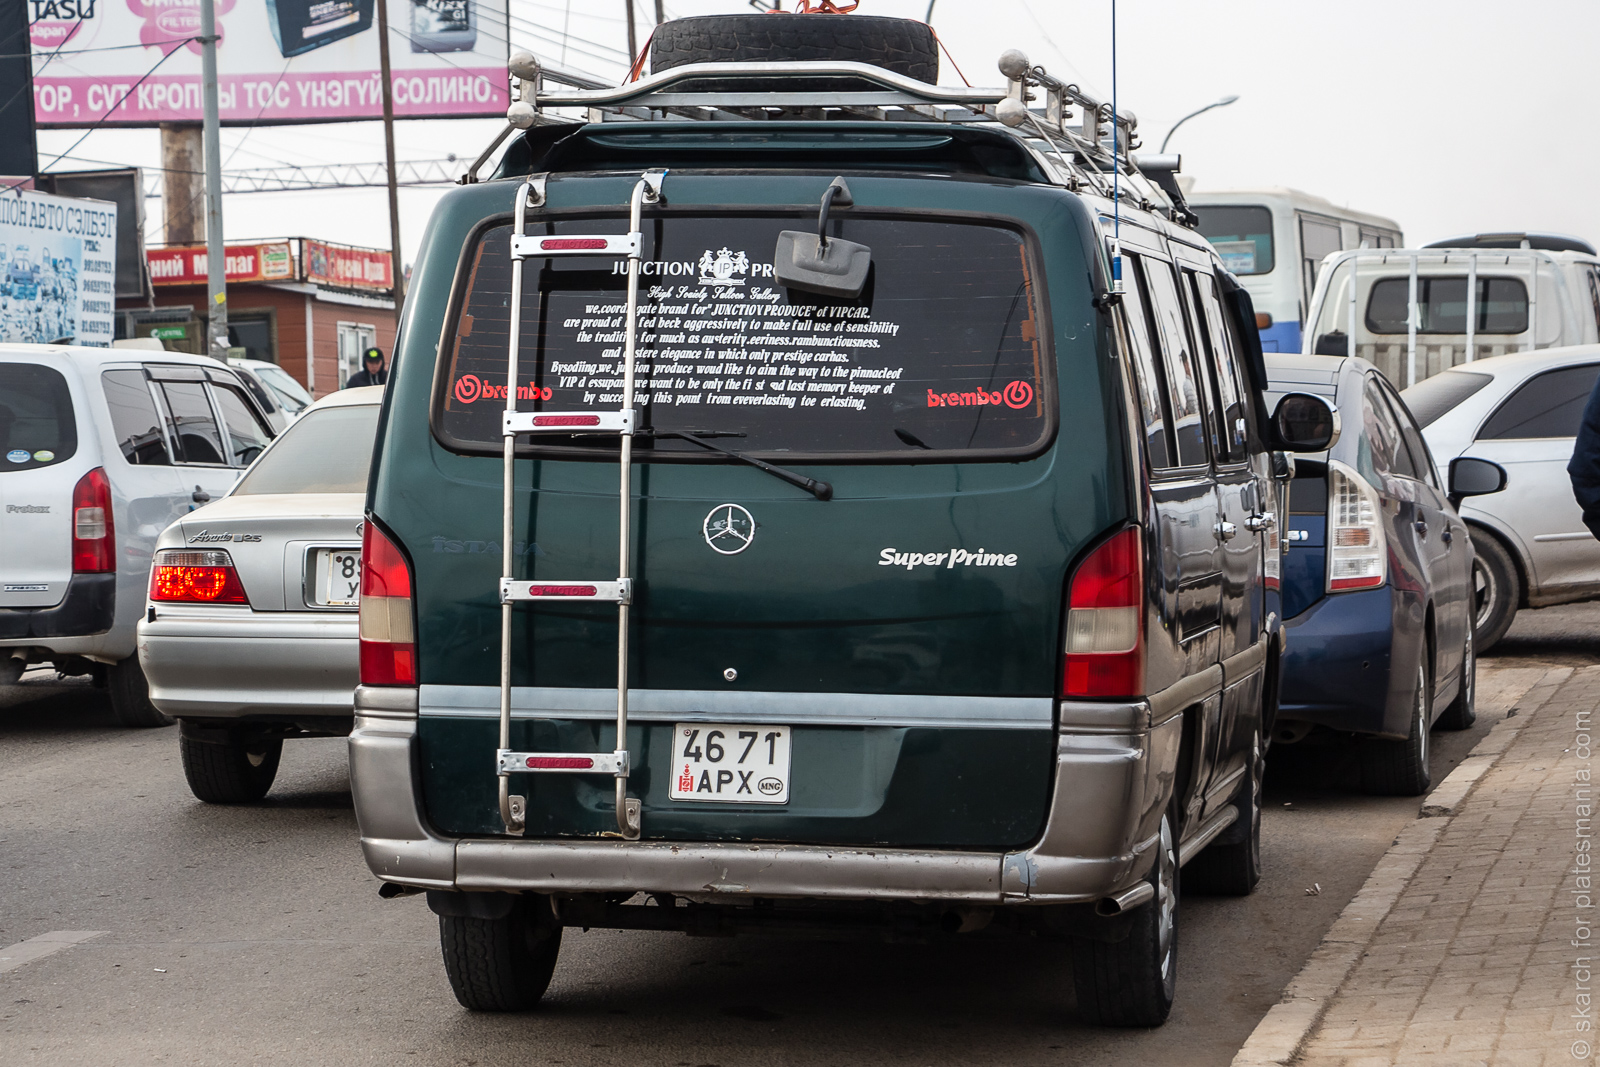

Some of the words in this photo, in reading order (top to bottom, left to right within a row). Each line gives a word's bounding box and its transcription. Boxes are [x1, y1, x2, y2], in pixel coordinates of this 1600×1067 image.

[31, 25, 67, 40] Japan
[138, 82, 237, 110] КРОПЫ
[243, 81, 290, 108] ТОС
[30, 201, 64, 232] АВТО
[66, 206, 115, 239] СЭЛБЭГ
[193, 254, 255, 276] Млаг
[751, 263, 777, 278] PR
[658, 302, 689, 315] brand
[816, 306, 829, 318] of
[563, 318, 580, 328] are
[580, 316, 611, 330] proud
[611, 316, 623, 328] of
[683, 317, 748, 332] aggressively
[749, 319, 761, 330] to
[762, 319, 791, 331] make
[791, 319, 813, 331] full
[813, 322, 832, 332] use
[833, 320, 847, 332] of
[845, 321, 900, 337] sensibility
[576, 331, 593, 343] the
[640, 332, 658, 344] for
[658, 332, 686, 344] much
[687, 334, 701, 344] as
[601, 347, 622, 358] and
[703, 348, 716, 360] in
[717, 347, 748, 361] which
[748, 349, 771, 364] only
[652, 362, 694, 376] produce
[723, 362, 744, 375] like
[745, 363, 757, 376] to
[757, 363, 778, 376] aim
[778, 364, 797, 377] the
[798, 366, 819, 380] way
[819, 365, 831, 378] to
[831, 365, 850, 378] the
[648, 378, 674, 390] want
[674, 378, 686, 389] to
[687, 377, 701, 390] be
[702, 378, 724, 392] only
[724, 378, 742, 391] the
[786, 379, 807, 392] last
[806, 382, 847, 396] memory
[847, 381, 882, 396] keeper
[882, 382, 896, 395] of
[582, 390, 597, 405] by
[653, 390, 673, 403] this
[927, 387, 1002, 408] brembo
[6, 504, 51, 514] Probox
[341, 555, 361, 579] 8
[760, 781, 781, 791] MNG
